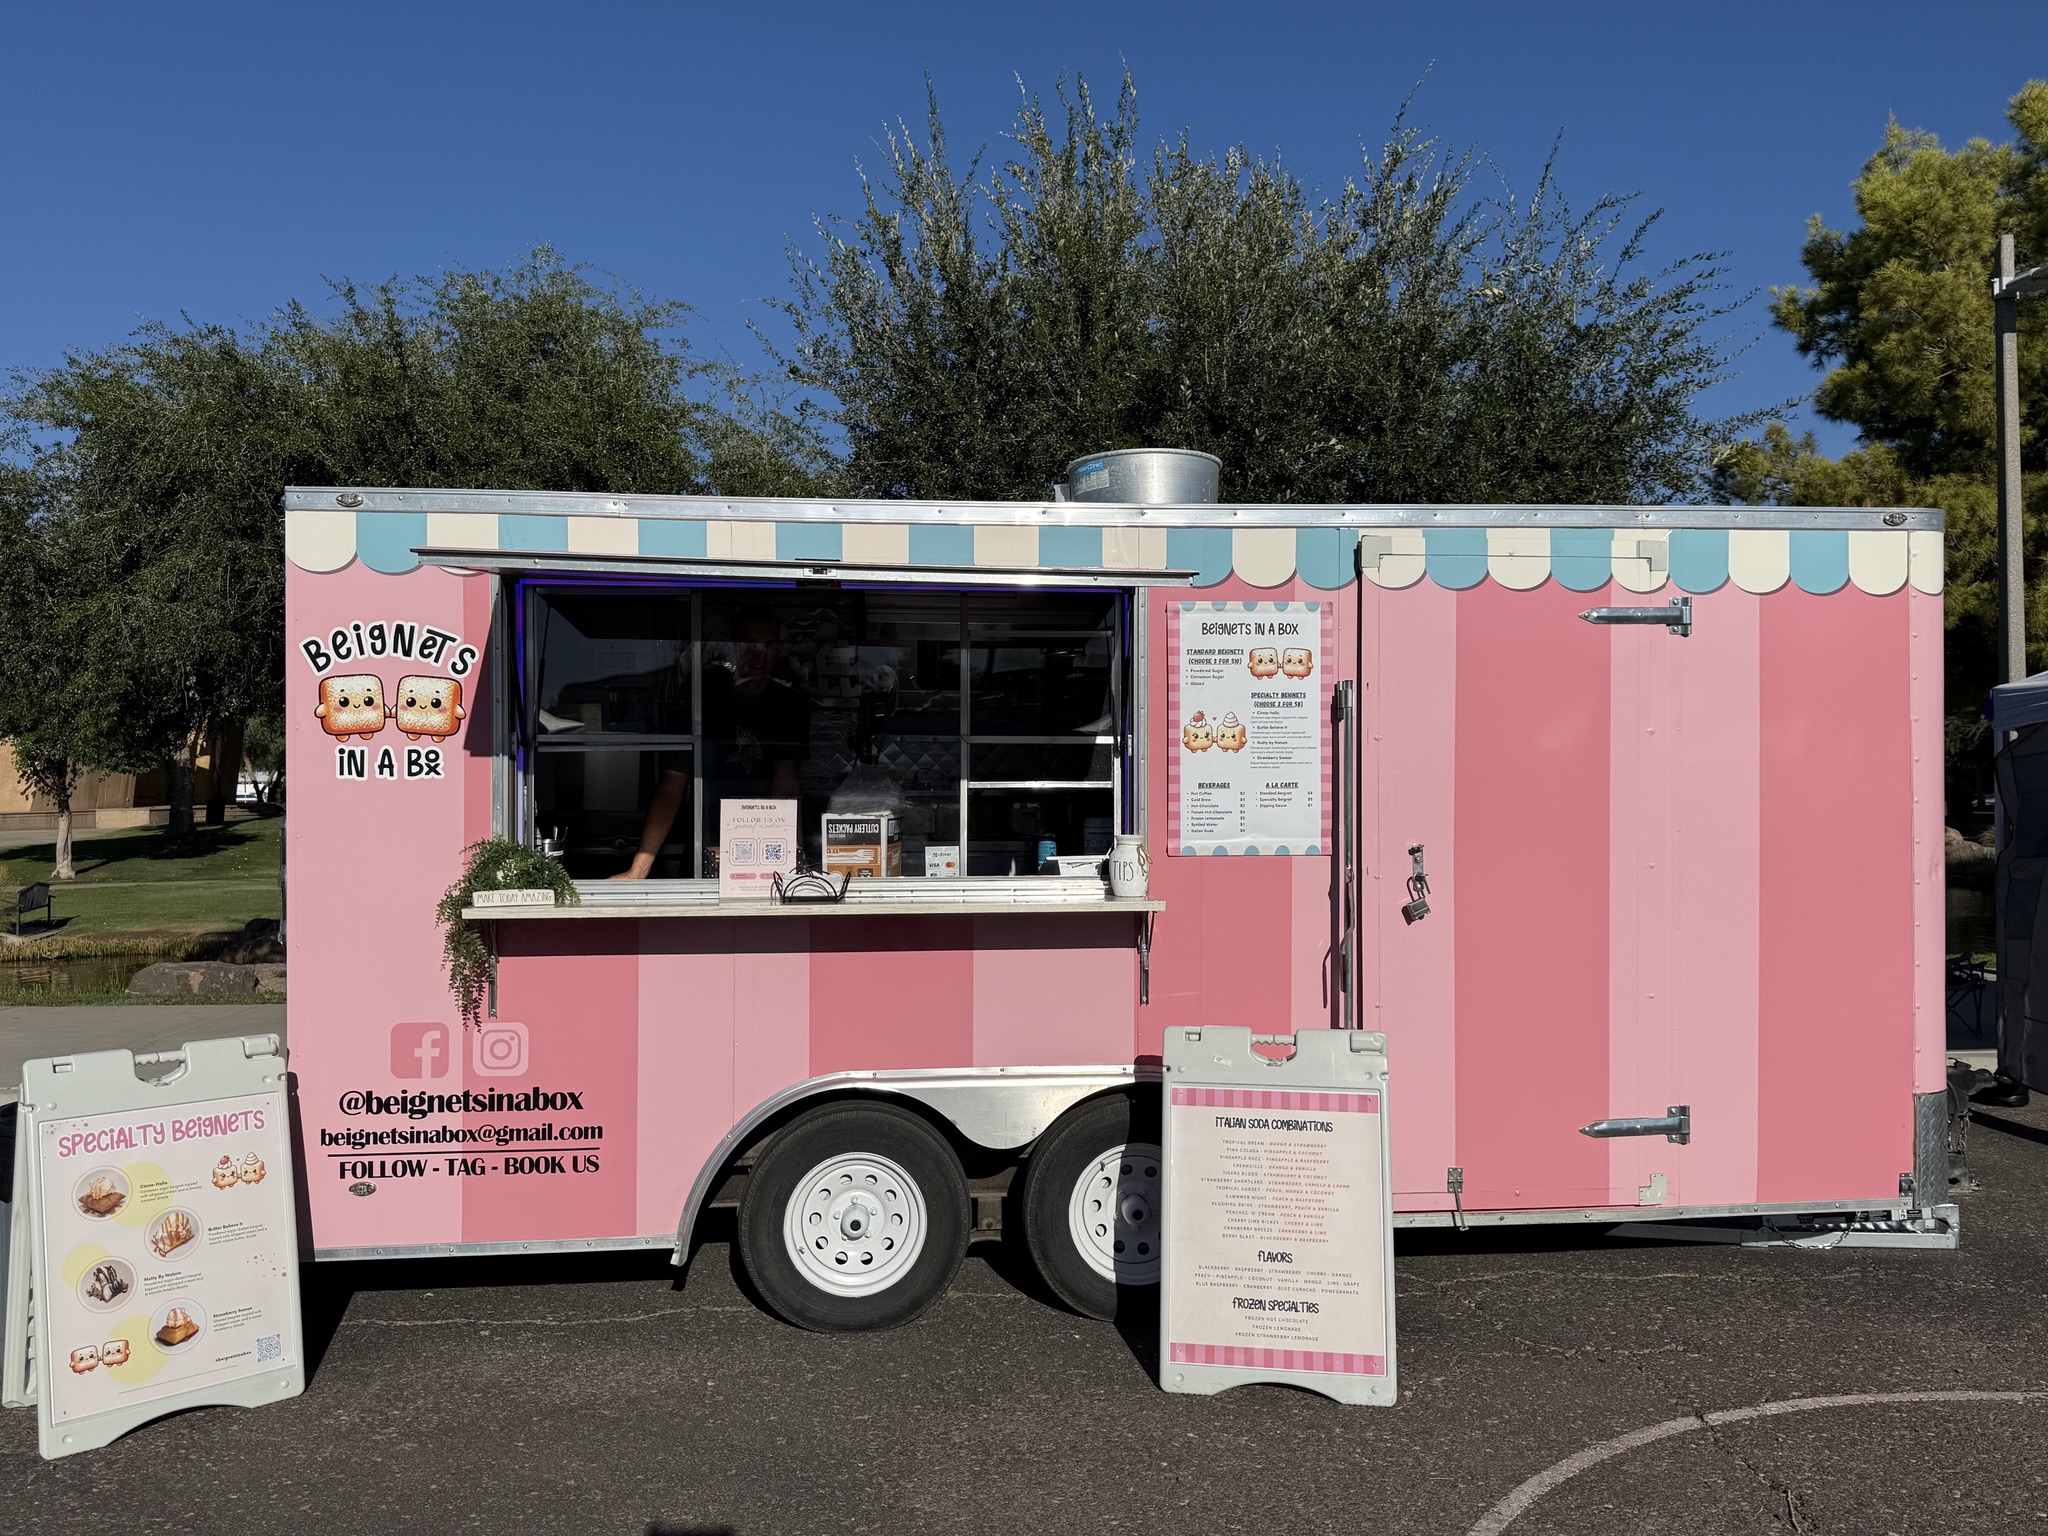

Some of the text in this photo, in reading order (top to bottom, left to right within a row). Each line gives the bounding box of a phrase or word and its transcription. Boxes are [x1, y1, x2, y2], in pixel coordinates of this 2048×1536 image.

[1202, 622, 1299, 635] BeigNeTS iN A BOX
[339, 748, 364, 777] iN
[378, 749, 394, 777] A
[829, 824, 879, 833] CUTLERY PACKETS
[1113, 860, 1133, 881] TIPS
[477, 892, 551, 904] MAKE TODAY AMAZING
[339, 1087, 584, 1119] @beignetsinabox
[1248, 1119, 1269, 1129] SODA
[321, 1123, 603, 1150] beignetsinabox@gmail.com
[339, 1155, 600, 1179] FOLLOW TAG BOOK US
[213, 1310, 237, 1318] Strawberry
